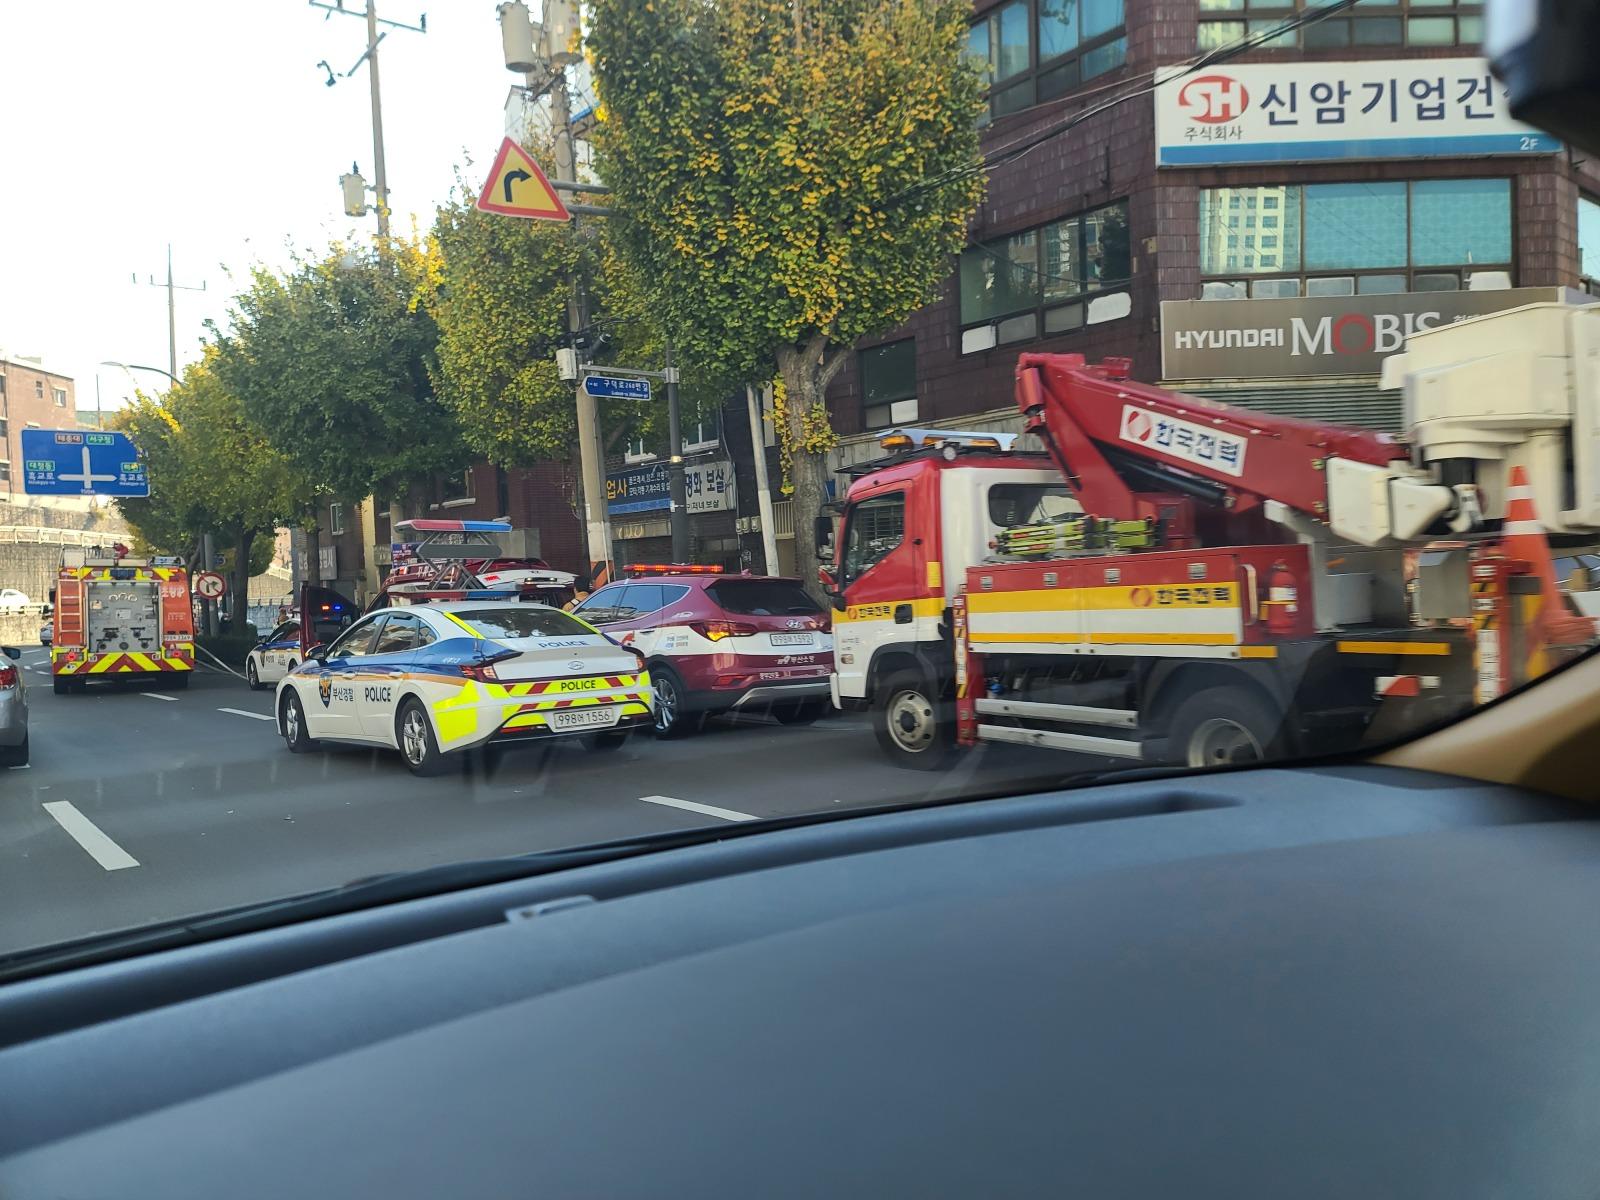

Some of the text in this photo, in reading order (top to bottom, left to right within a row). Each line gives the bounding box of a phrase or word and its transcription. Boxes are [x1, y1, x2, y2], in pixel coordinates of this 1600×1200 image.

[1260, 75, 1509, 126] 신암기업건
[1184, 125, 1243, 142] 주식회사
[1520, 137, 1539, 151] 2F
[1175, 328, 1285, 349] HYUNDAI
[538, 640, 590, 648] POLICE
[560, 680, 596, 691] POLICE
[332, 687, 354, 702] 부산경찰
[364, 687, 391, 703] POLICE
